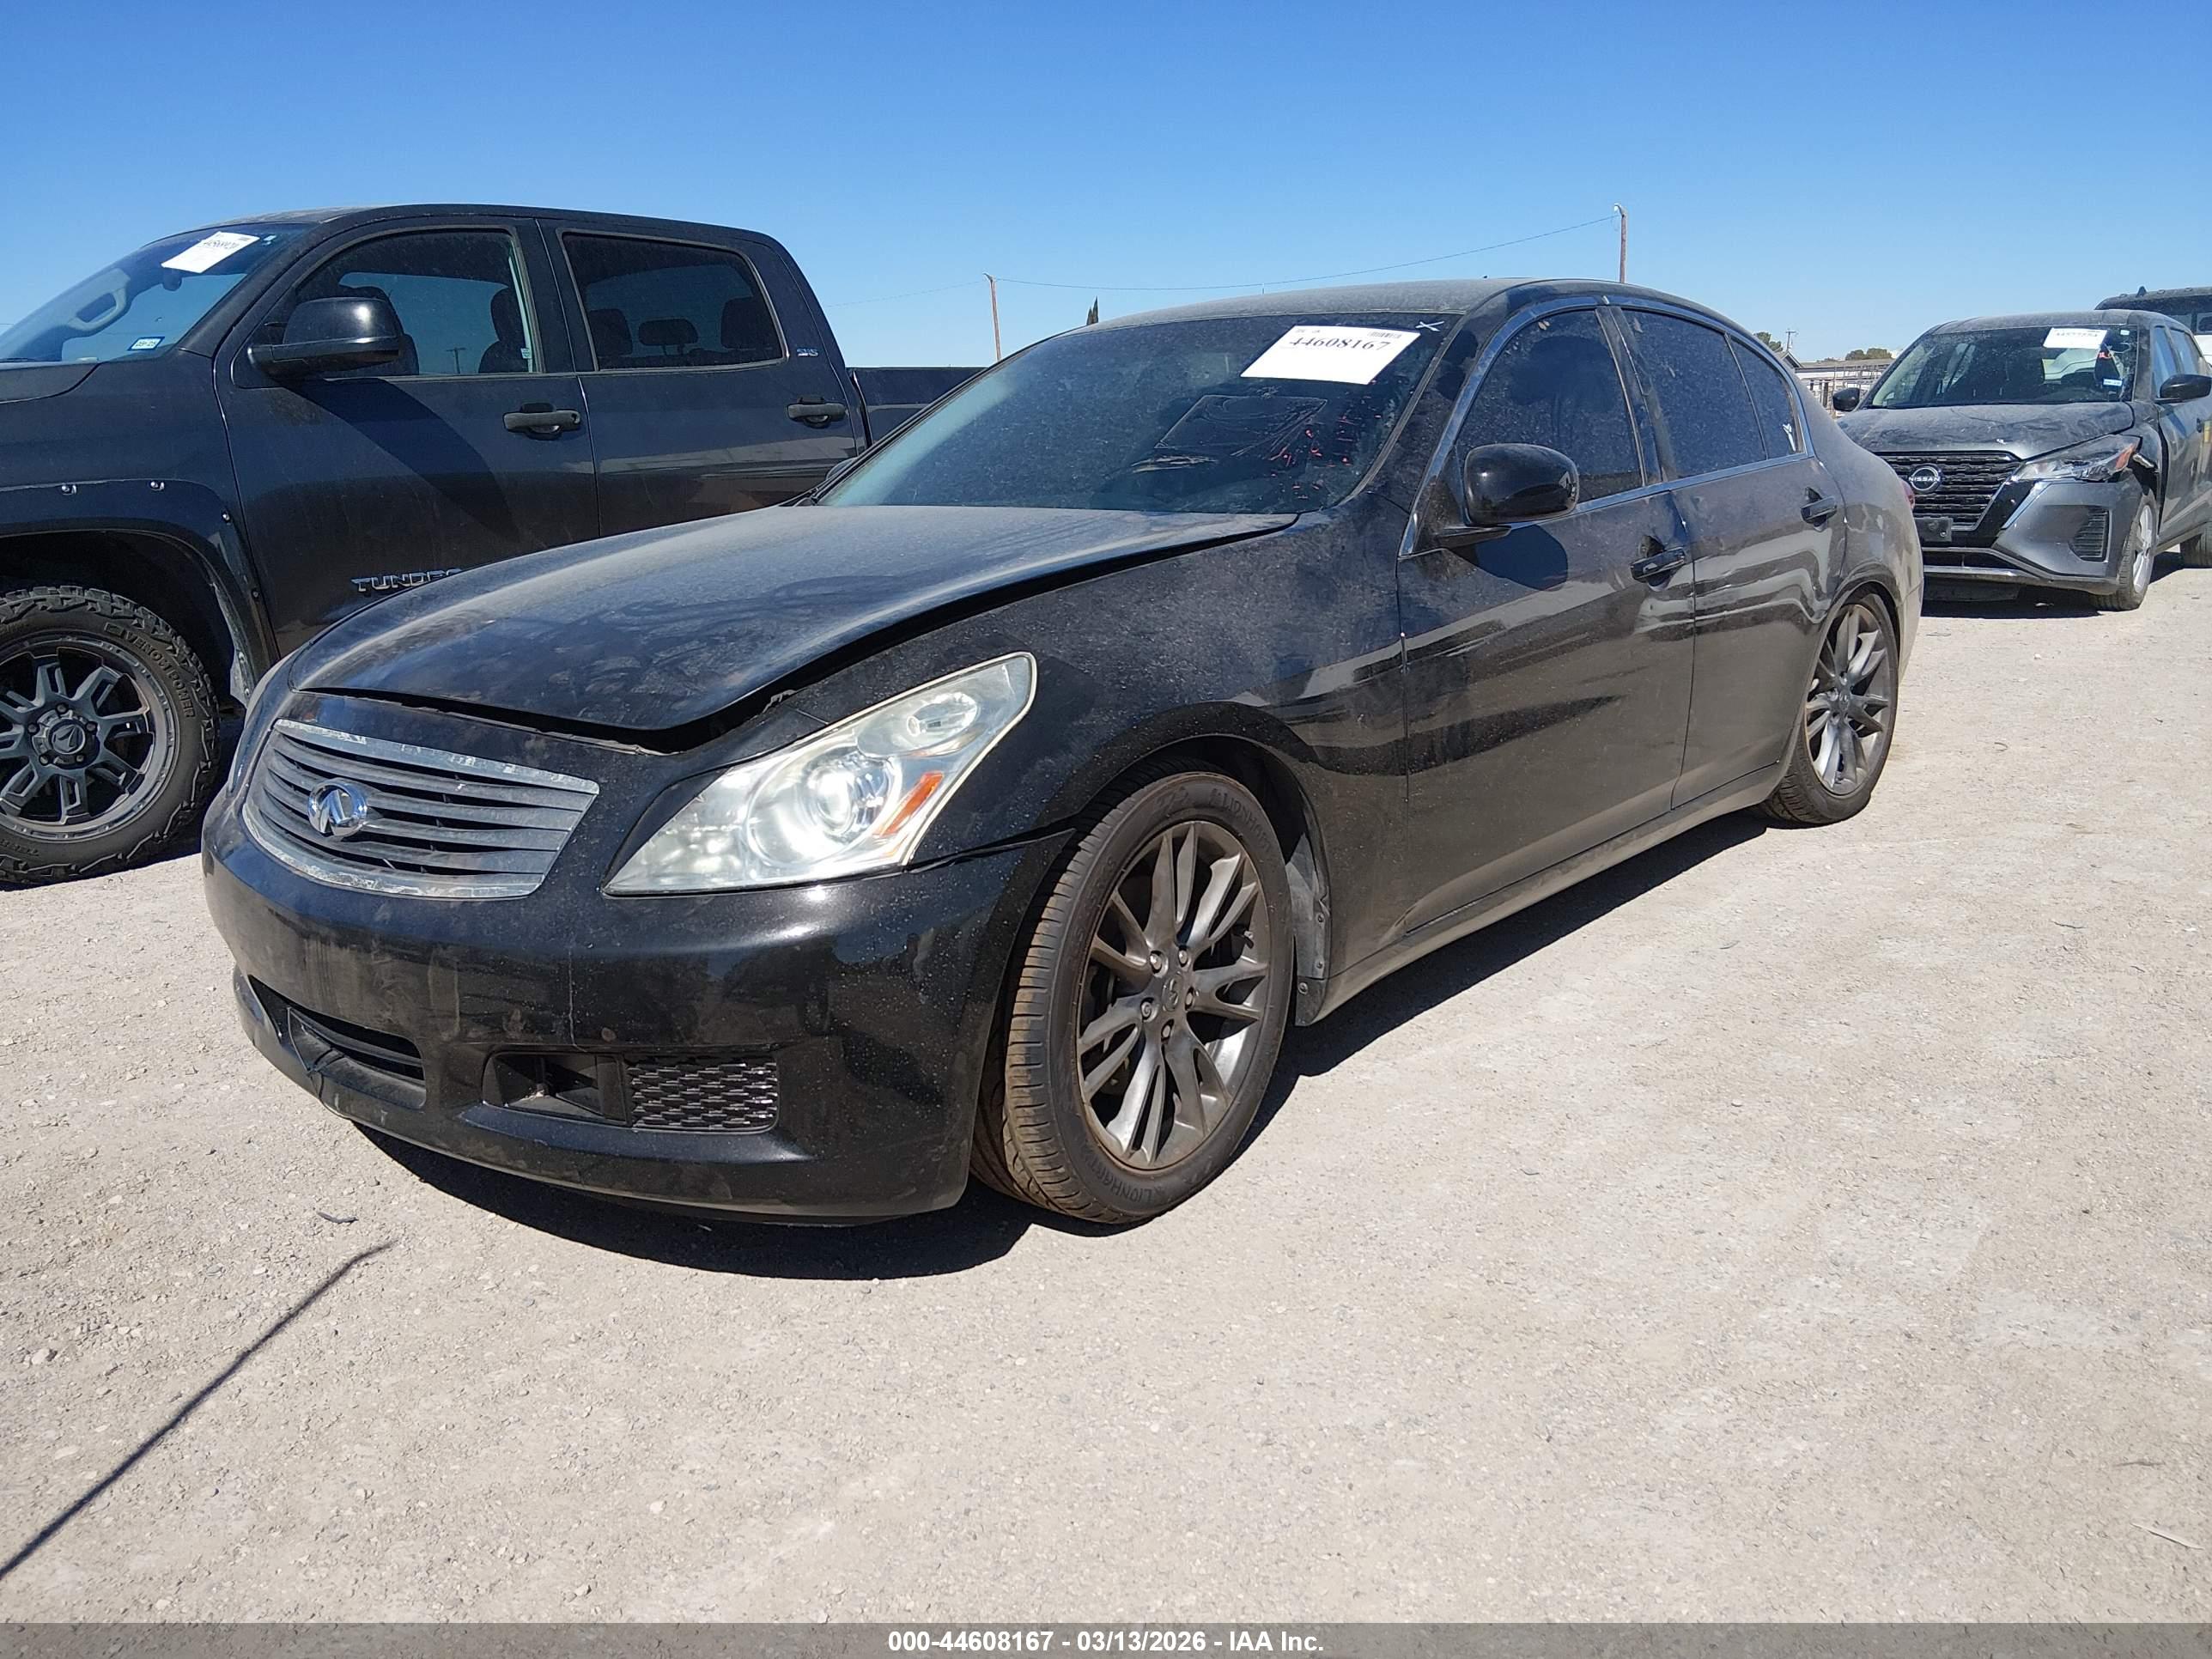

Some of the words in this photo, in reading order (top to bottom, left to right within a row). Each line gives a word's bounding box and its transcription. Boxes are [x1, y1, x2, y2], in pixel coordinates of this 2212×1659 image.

[1290, 337, 1391, 350] 44608167
[350, 568, 463, 592] TUNDR
[124, 630, 172, 670] VENOM
[167, 669, 196, 718] POWER
